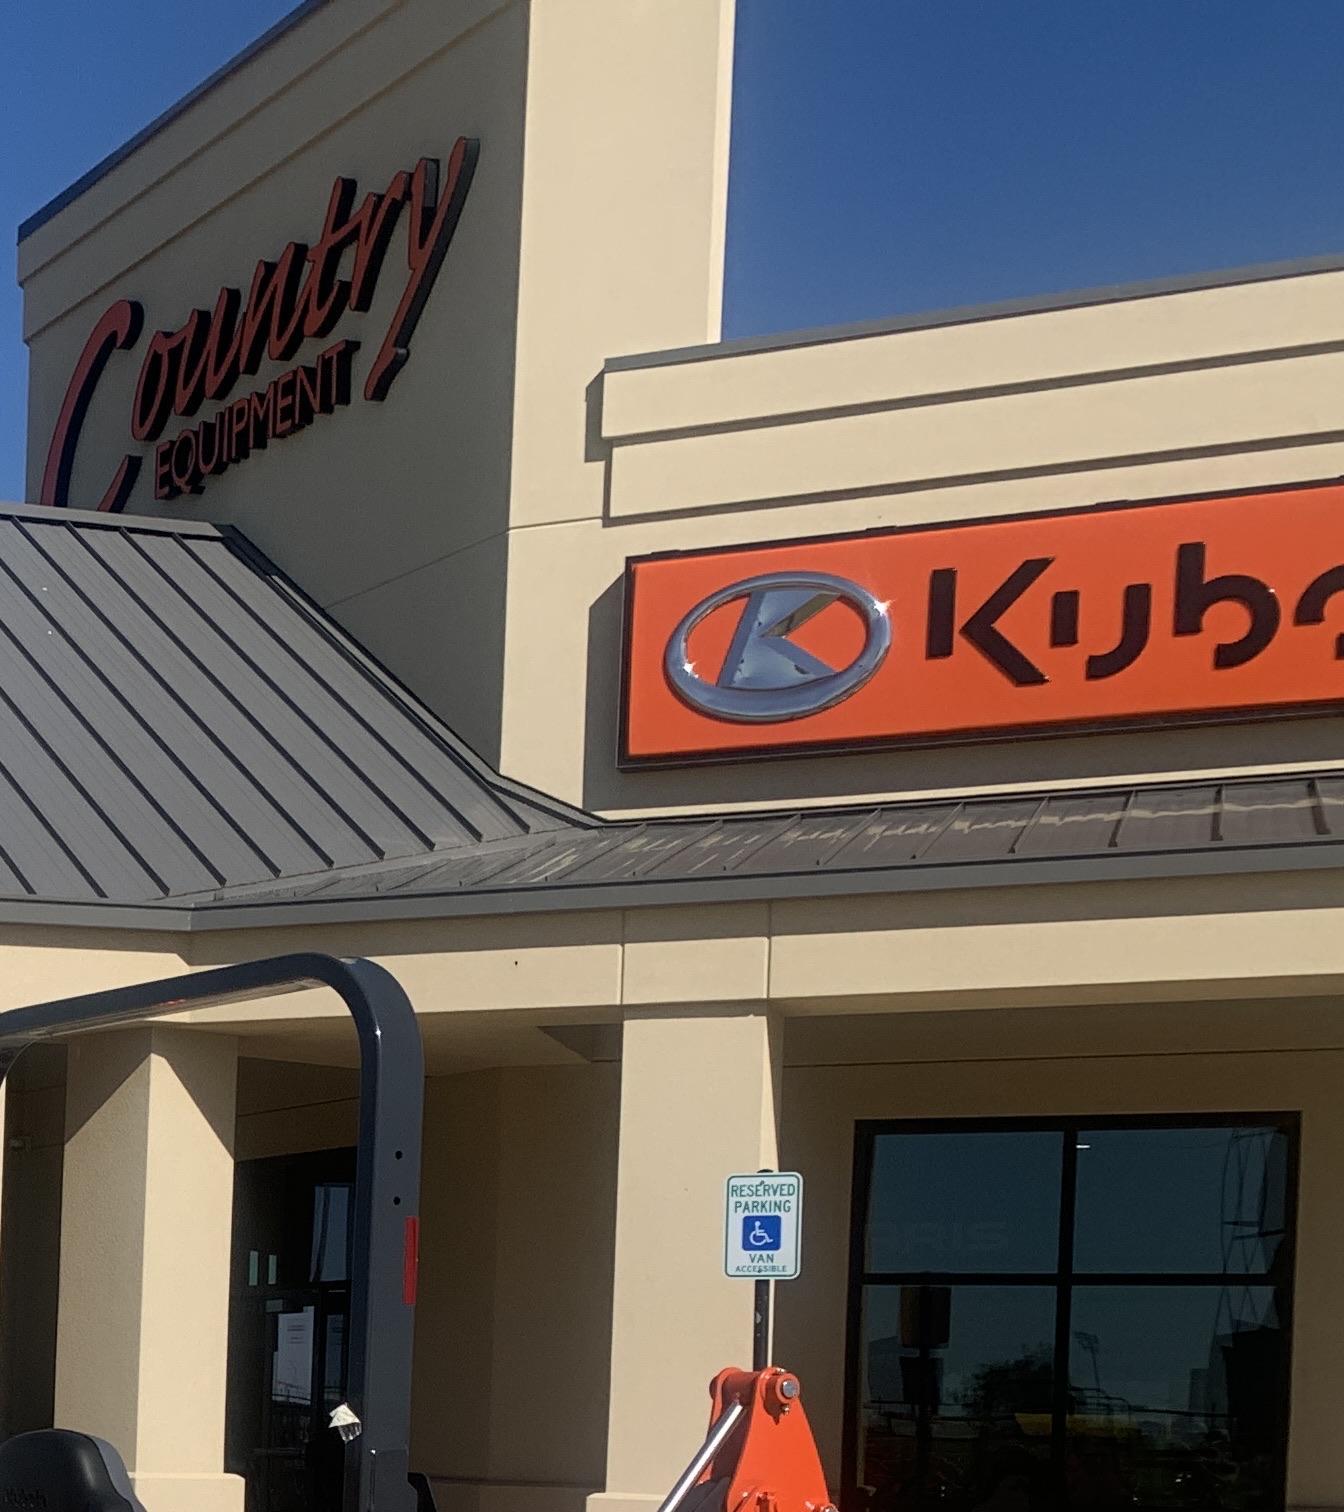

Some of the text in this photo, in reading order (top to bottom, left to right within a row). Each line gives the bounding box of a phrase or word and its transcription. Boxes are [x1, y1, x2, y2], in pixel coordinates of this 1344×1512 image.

[41, 136, 480, 511] Country
[154, 339, 361, 500] EQUIPMENT
[731, 1183, 796, 1198] RESERVED
[734, 1200, 792, 1213] PARKING
[748, 1253, 774, 1264] VAN
[735, 1265, 787, 1273] ACCESSIBLE
